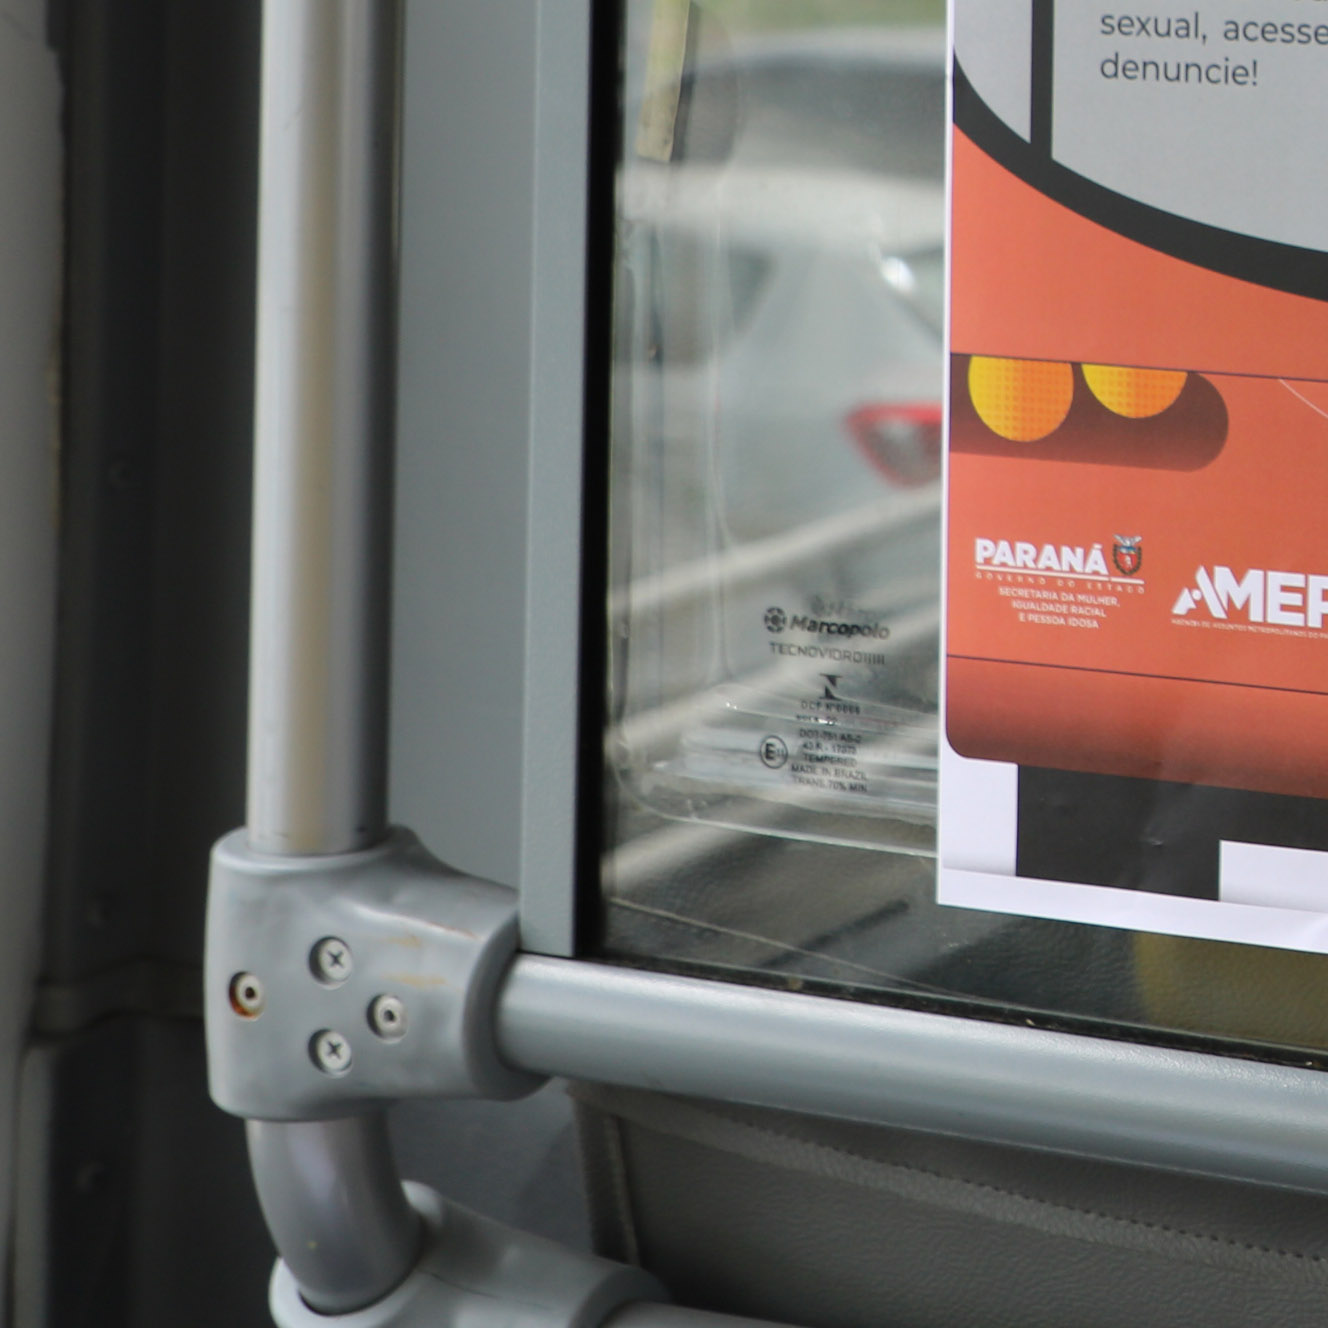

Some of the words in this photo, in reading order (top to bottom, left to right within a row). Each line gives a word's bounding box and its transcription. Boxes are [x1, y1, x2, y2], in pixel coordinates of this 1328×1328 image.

[1100, 12, 1207, 45] sexual,
[1100, 52, 1259, 86] denuncie!
[975, 537, 1109, 575] PARANÁ
[998, 586, 1058, 601] SECRETARIA
[1061, 592, 1075, 603] DA
[1011, 599, 1068, 614] IGUALDADE
[1071, 606, 1107, 618] RACIAL
[1019, 612, 1026, 622] E
[1028, 614, 1066, 626] PESSOA
[1069, 617, 1099, 629] IDOSA
[789, 614, 890, 640] Marcopolo
